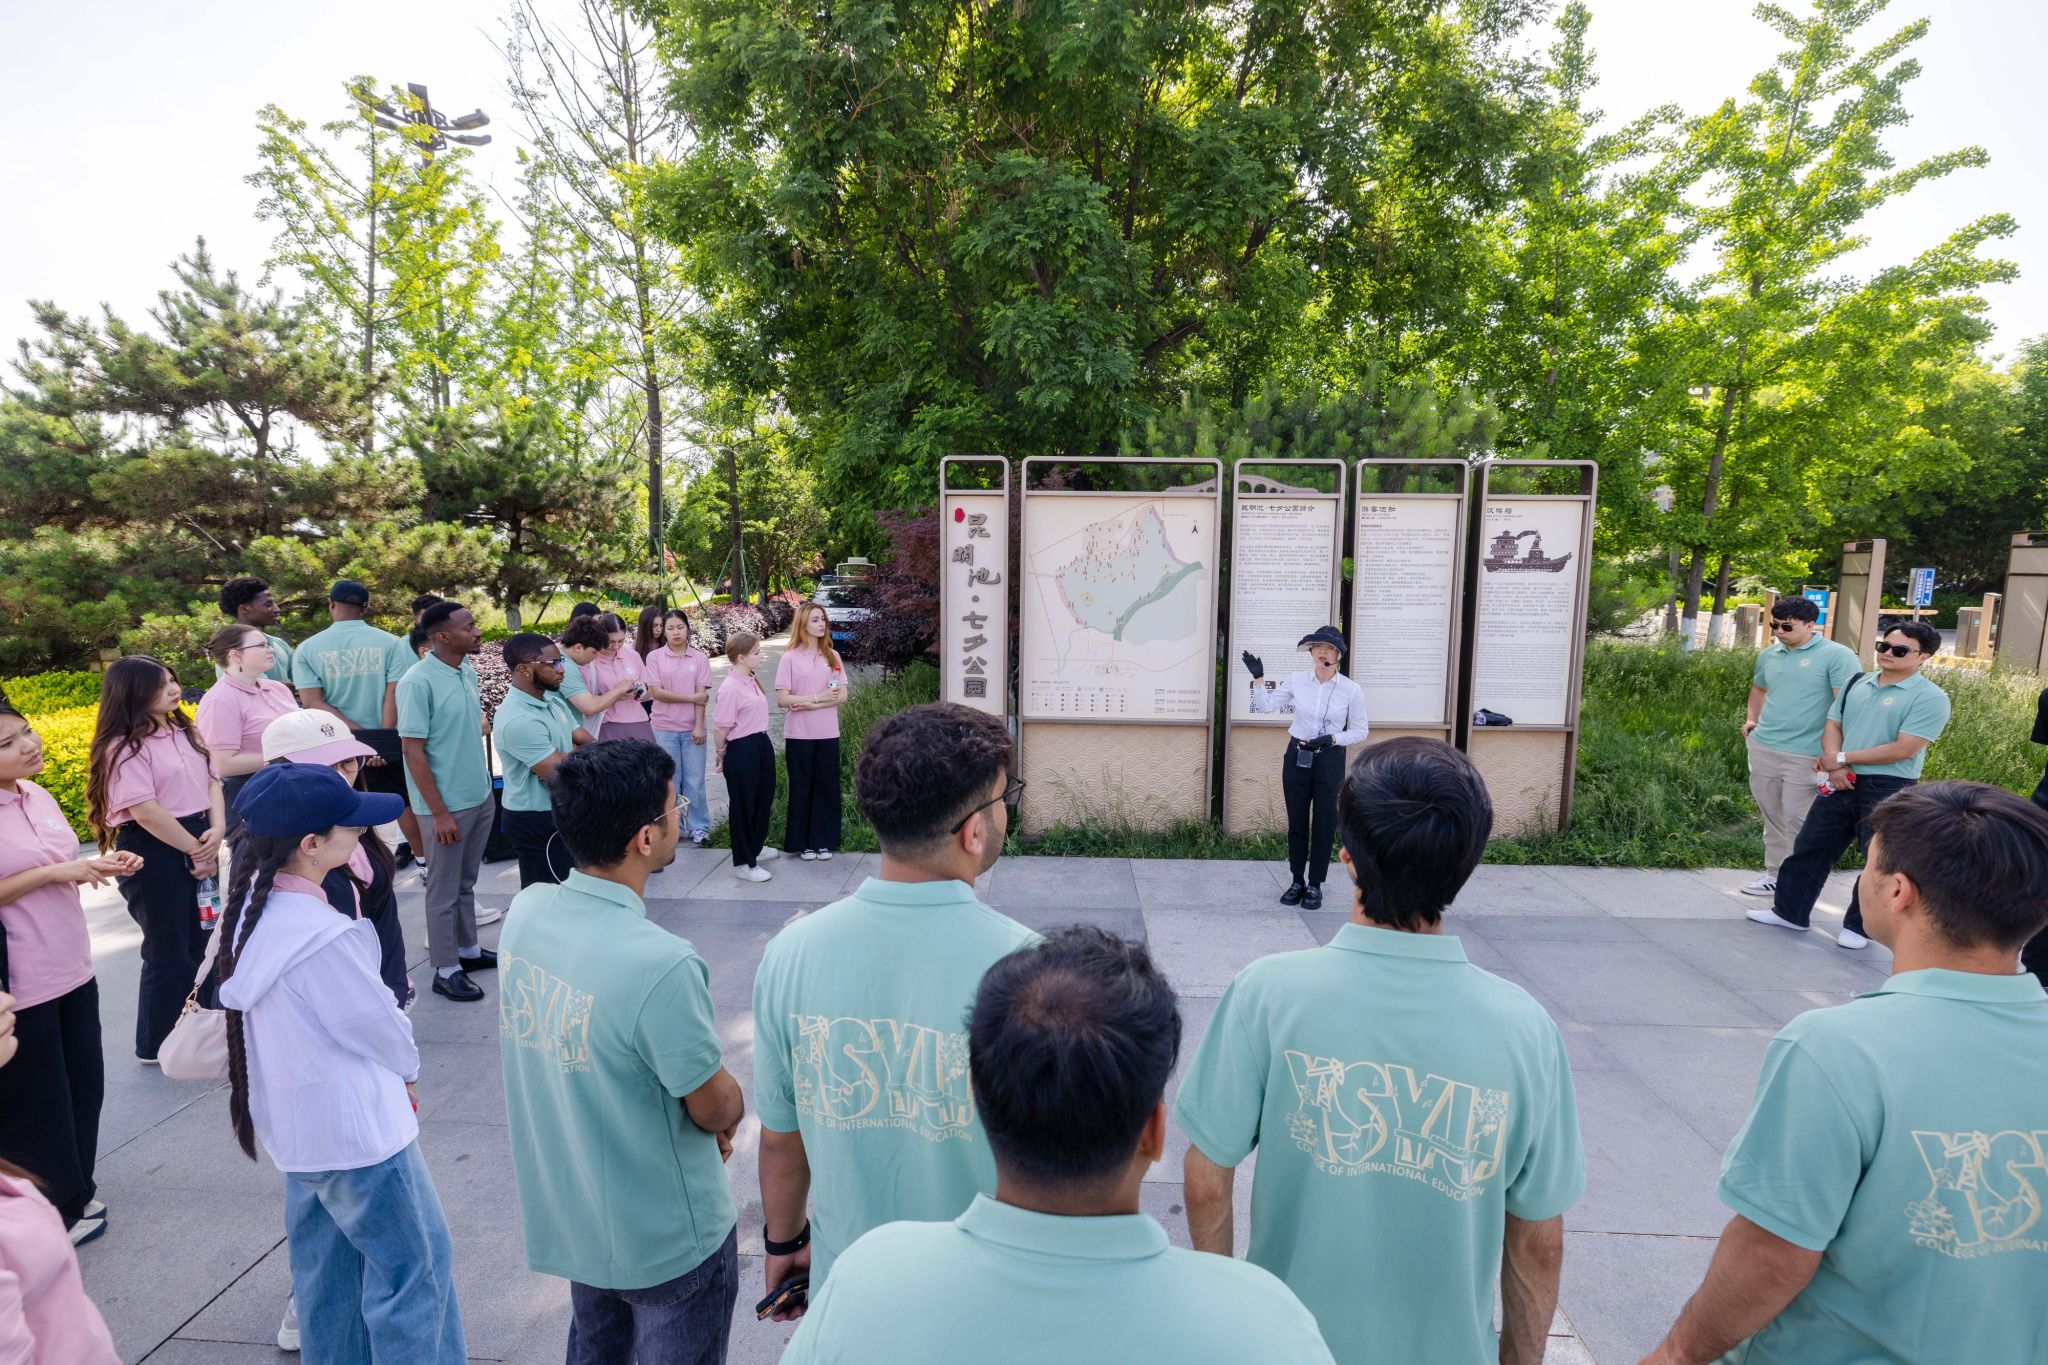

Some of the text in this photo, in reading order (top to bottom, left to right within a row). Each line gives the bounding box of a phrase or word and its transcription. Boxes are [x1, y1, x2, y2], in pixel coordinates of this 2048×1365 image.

[839, 1118, 918, 1133] INTERNATIONAL
[1328, 1164, 1345, 1176] OF
[1347, 1162, 1429, 1184] INTERNATIONAL
